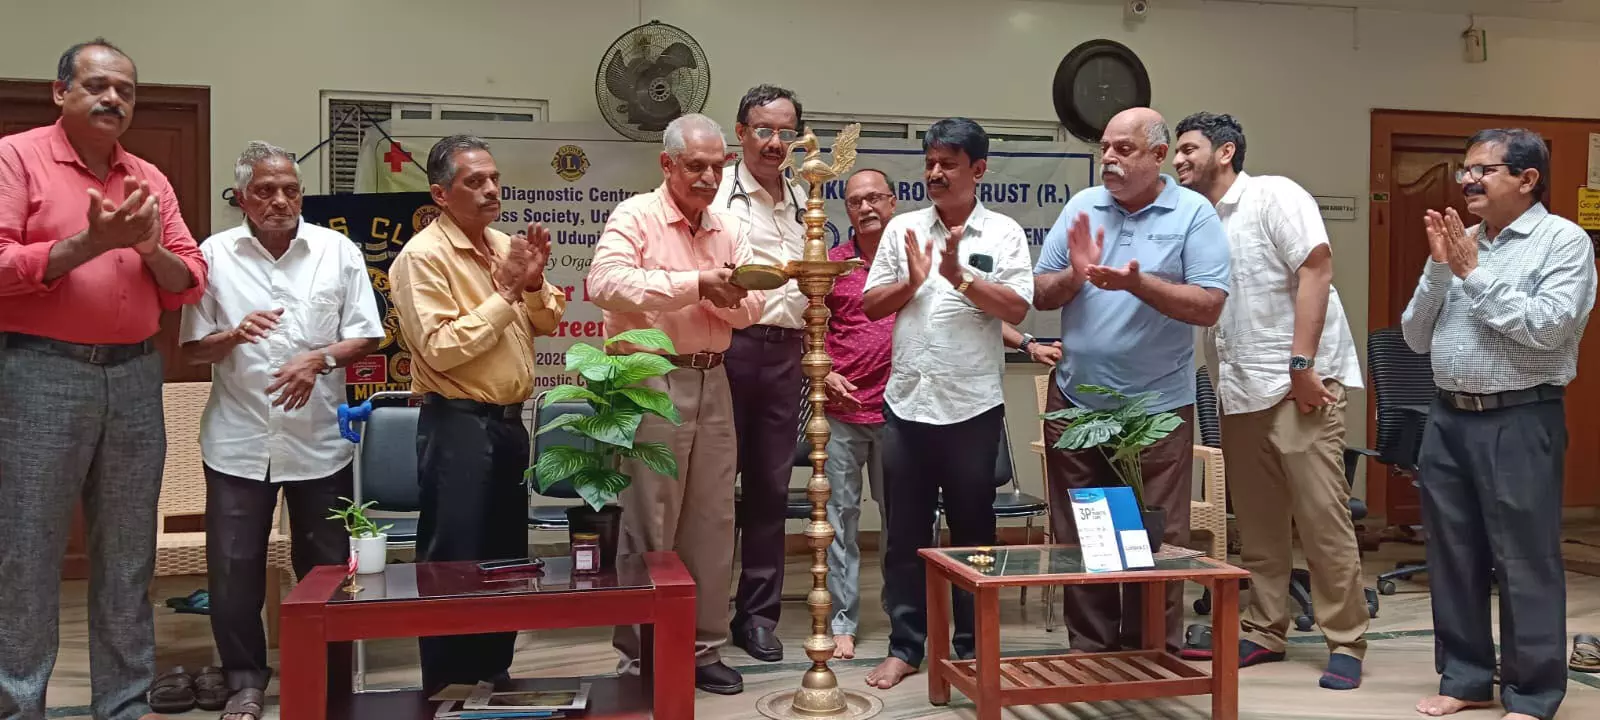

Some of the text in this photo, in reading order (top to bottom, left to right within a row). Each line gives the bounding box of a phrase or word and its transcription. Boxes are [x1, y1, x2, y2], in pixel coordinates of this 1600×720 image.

[501, 186, 583, 204] Diagnostic
[1037, 183, 1070, 208] (R.)
[523, 208, 586, 226] Society,
